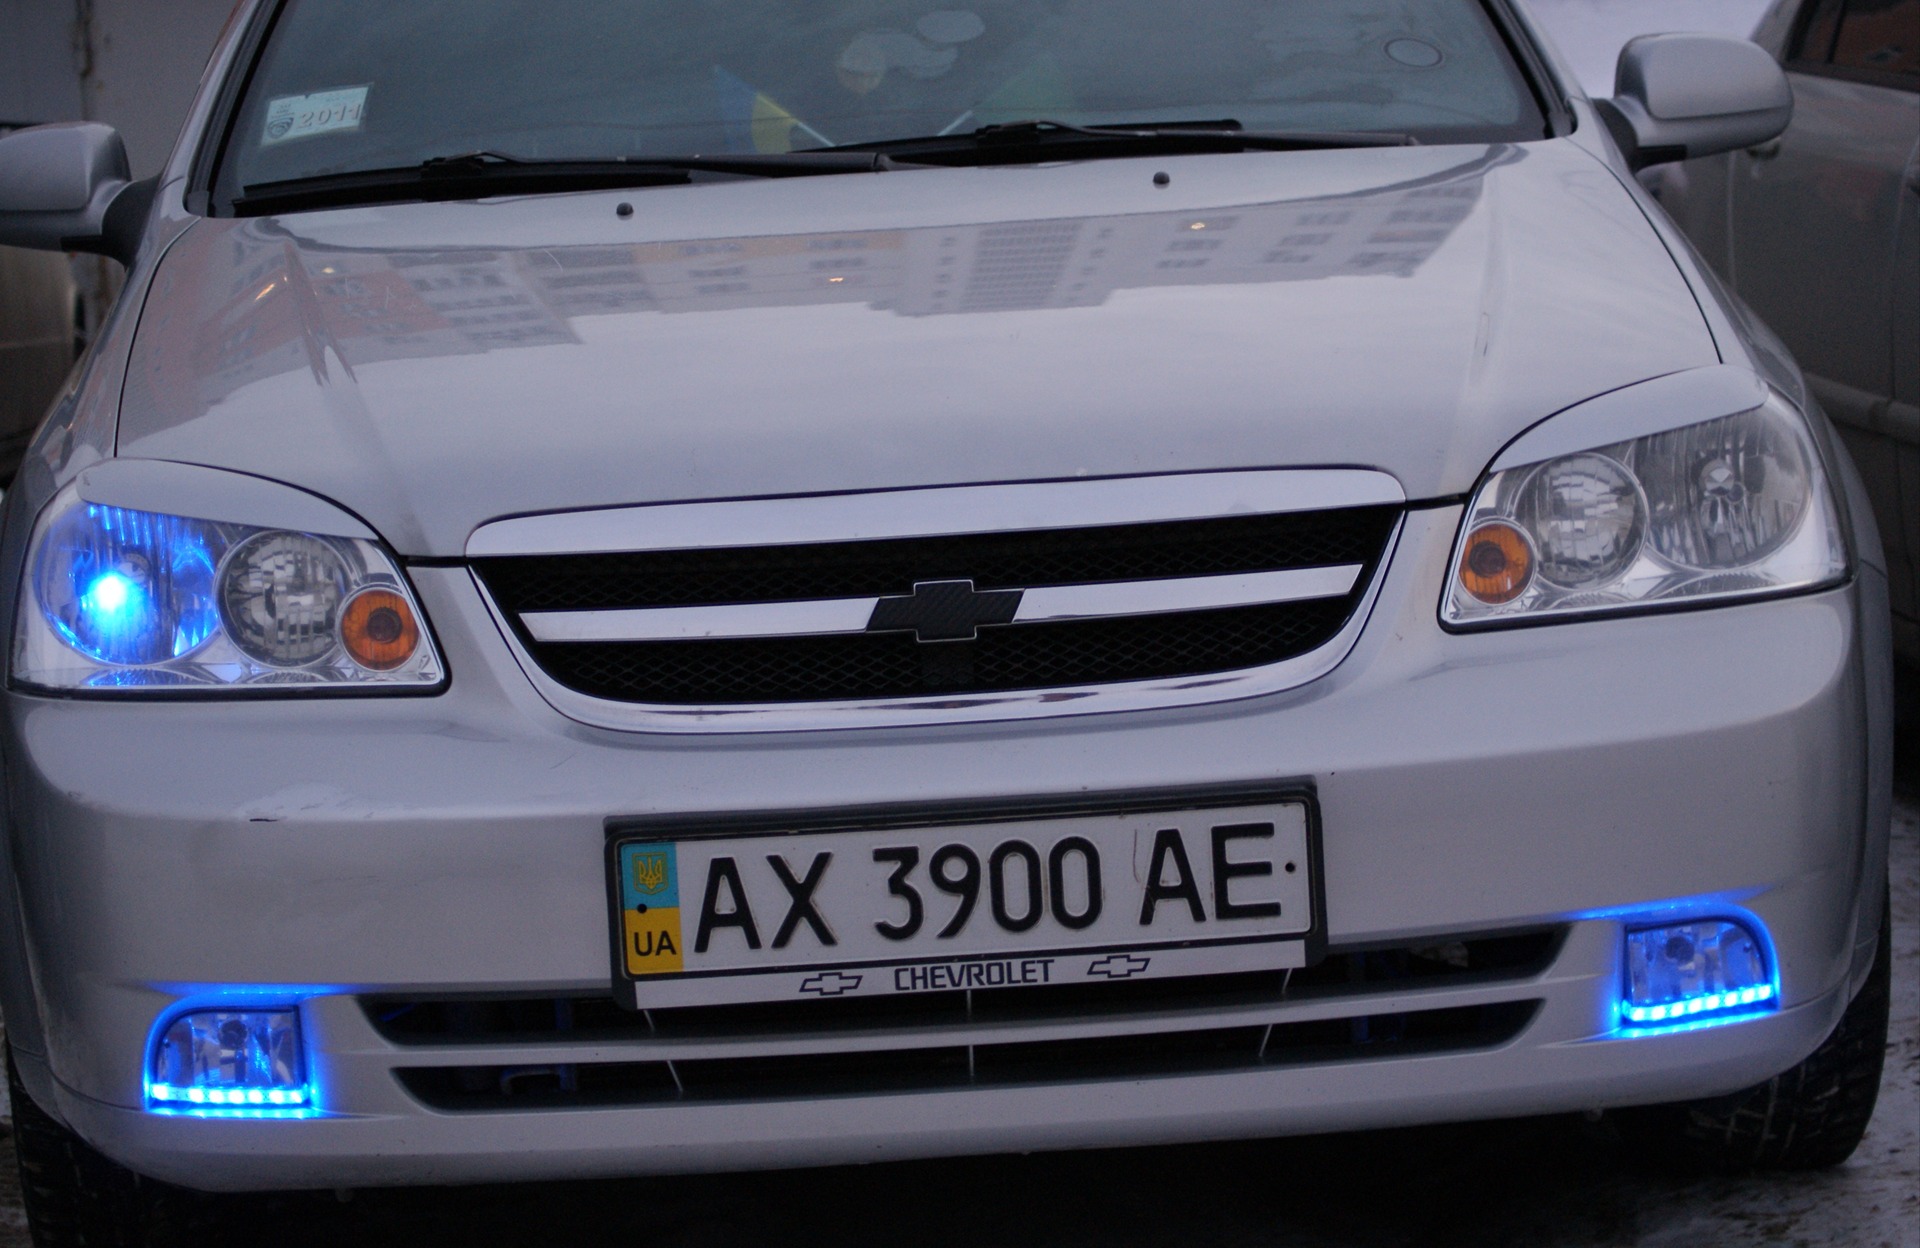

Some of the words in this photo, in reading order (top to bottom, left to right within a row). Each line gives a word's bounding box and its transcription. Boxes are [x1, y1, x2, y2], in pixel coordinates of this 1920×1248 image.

[298, 104, 361, 128] 2011
[694, 852, 837, 953] AX
[873, 836, 1102, 941] 3900
[1139, 823, 1282, 925] AE
[634, 931, 676, 956] UA
[894, 959, 1055, 990] CHEVROLET
